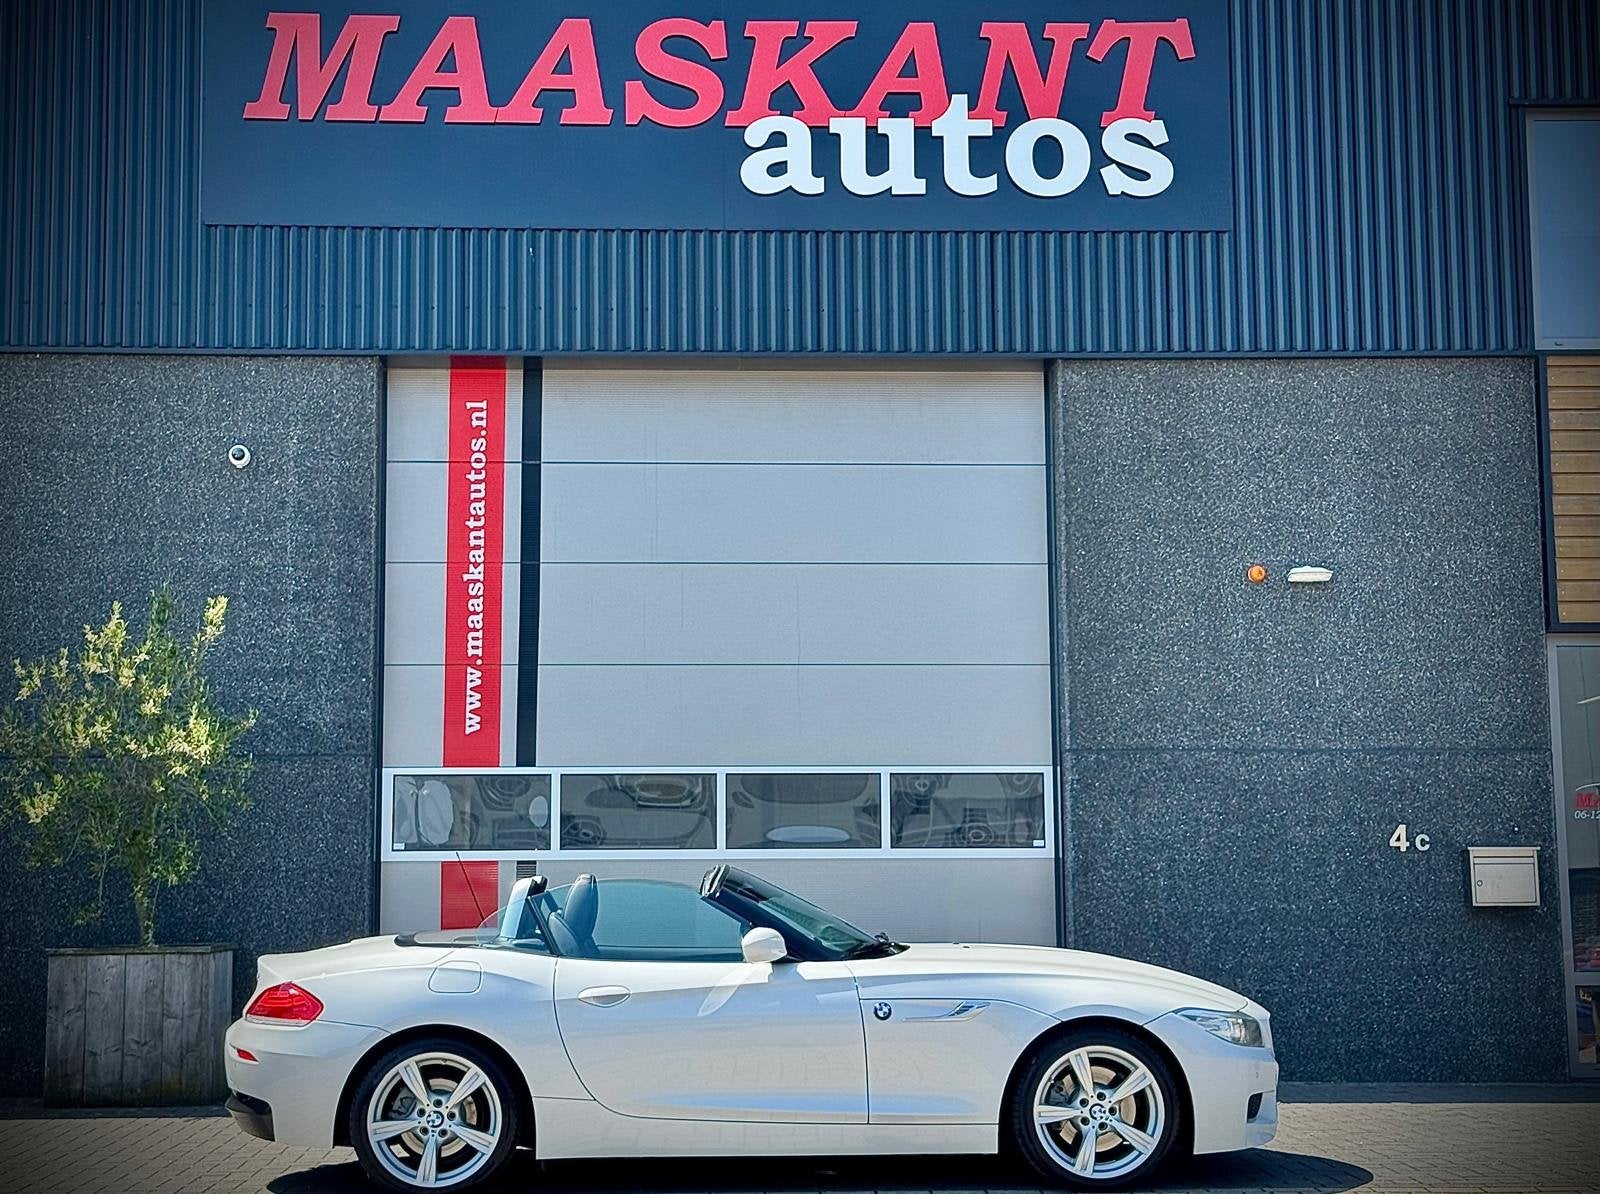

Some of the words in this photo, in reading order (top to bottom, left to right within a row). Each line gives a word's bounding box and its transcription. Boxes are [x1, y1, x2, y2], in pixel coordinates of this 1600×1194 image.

[243, 12, 1196, 128] MAASKANT
[740, 93, 1174, 196] autos
[463, 399, 488, 735] www.maaskantautos.nl
